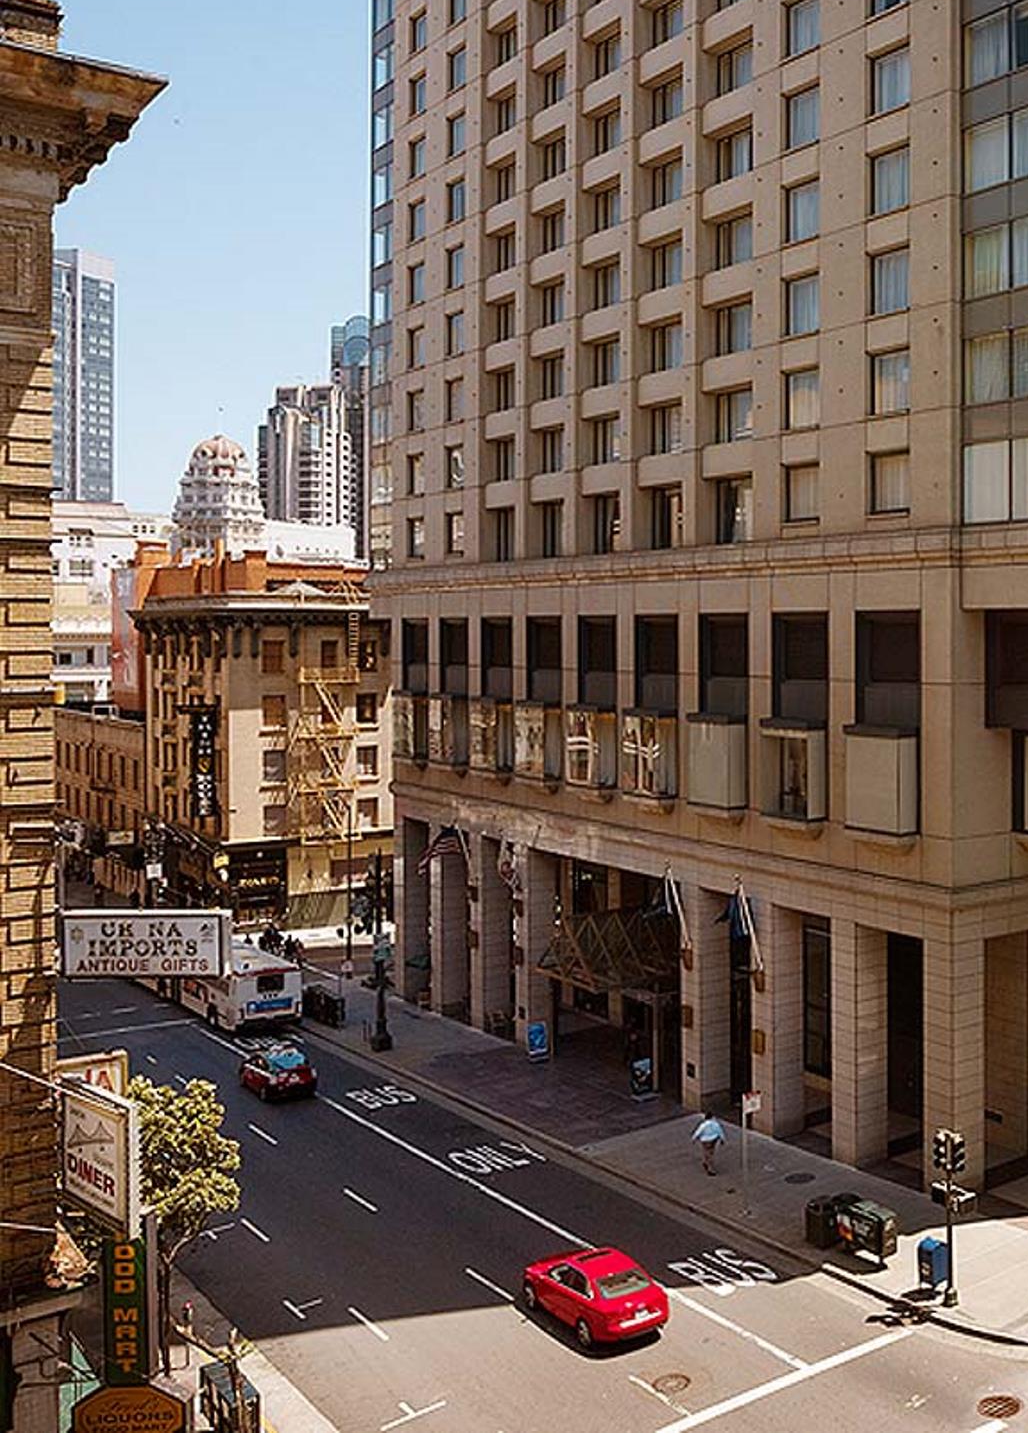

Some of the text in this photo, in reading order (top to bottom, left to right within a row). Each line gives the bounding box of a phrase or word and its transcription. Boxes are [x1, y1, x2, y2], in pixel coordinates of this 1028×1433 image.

[88, 938, 198, 956] IMPORTS
[77, 958, 208, 972] ANTIQUE GIFTS
[345, 1085, 418, 1110] BUS
[448, 1140, 547, 1174] ONLY
[66, 1152, 115, 1197] DINER
[667, 1248, 778, 1297] BUS
[113, 1307, 139, 1373] MART
[85, 1410, 175, 1426] LIQUORS
